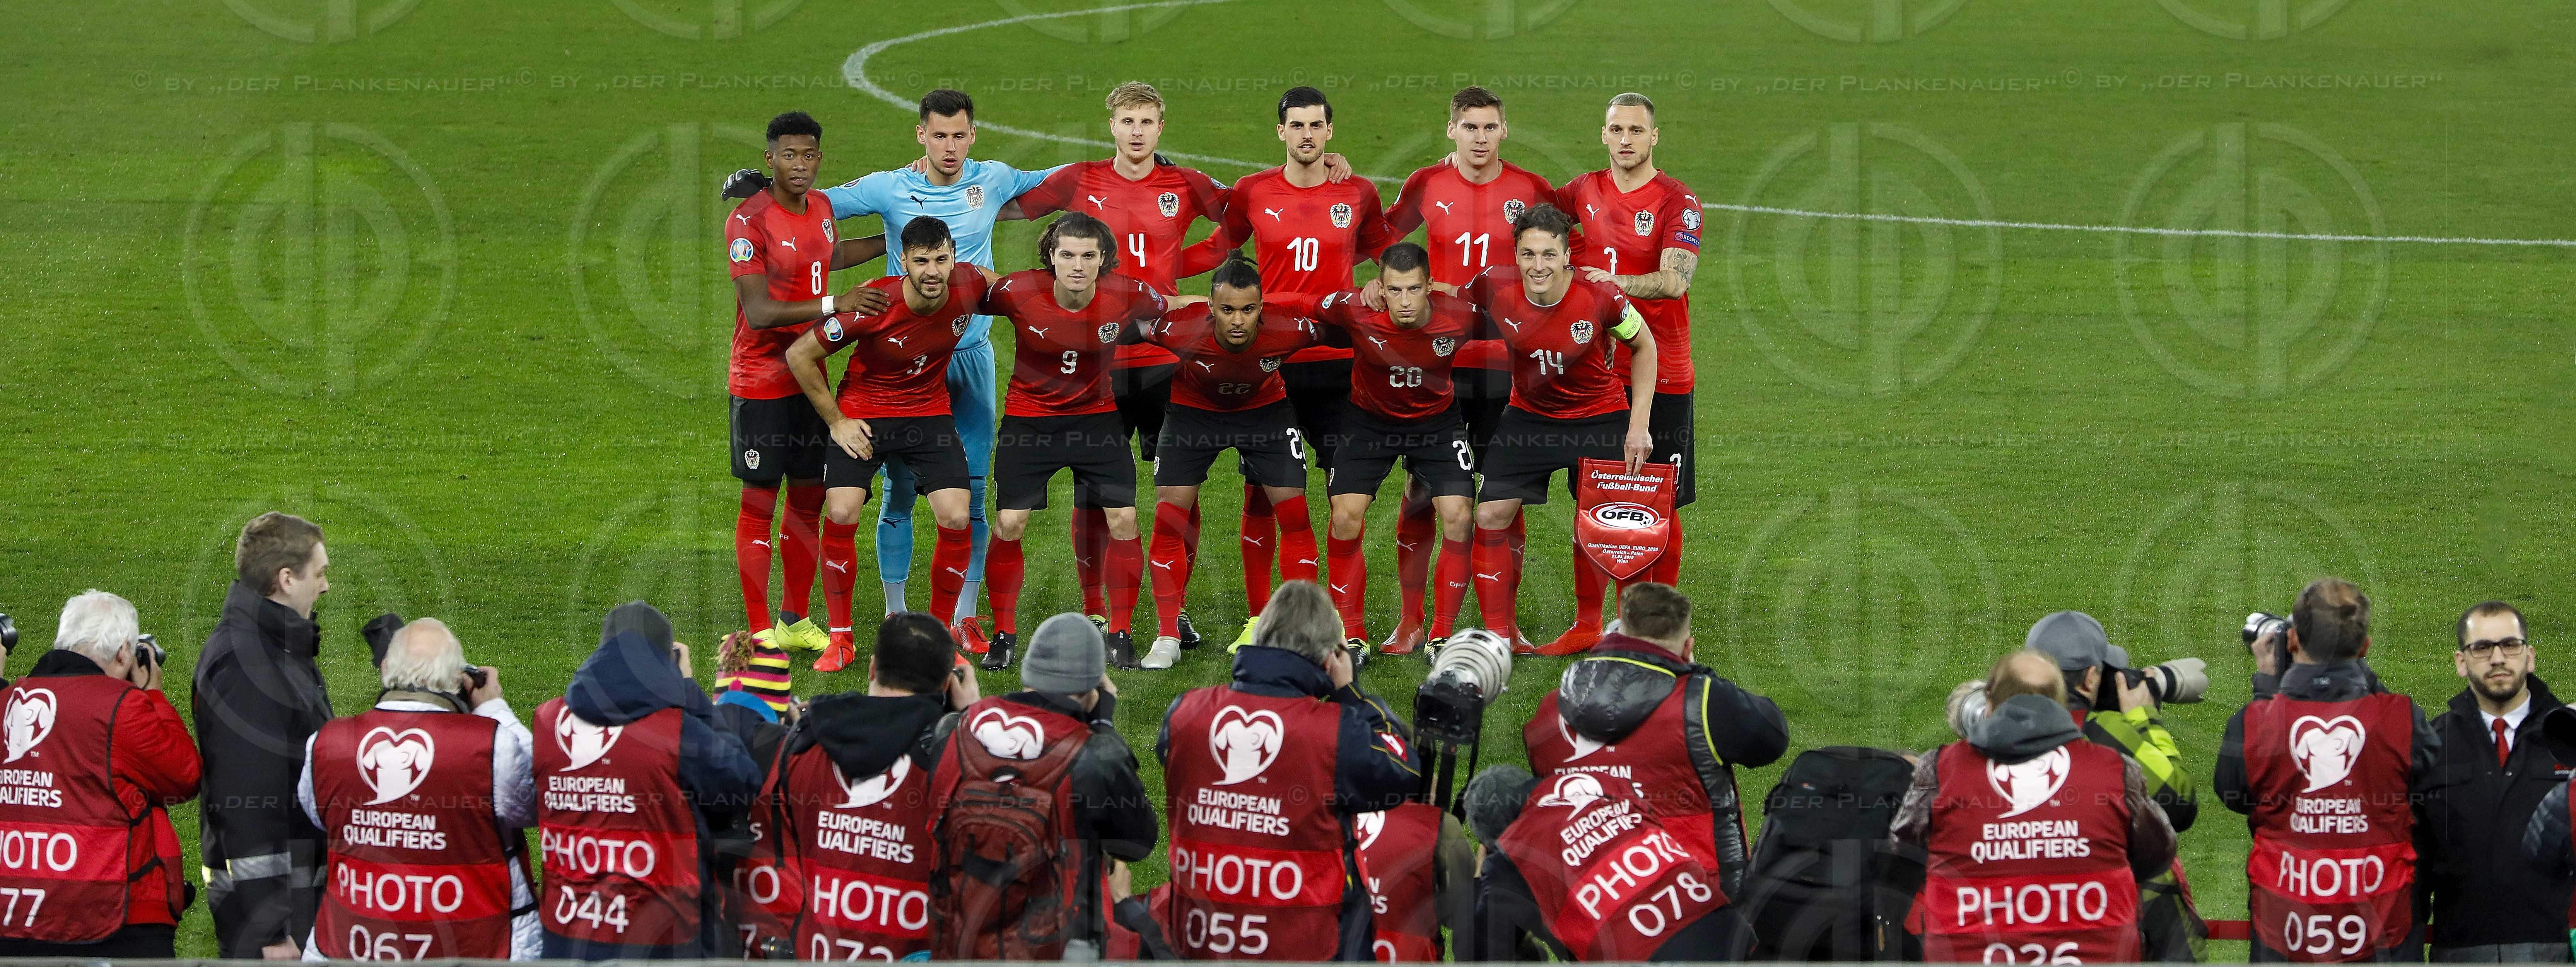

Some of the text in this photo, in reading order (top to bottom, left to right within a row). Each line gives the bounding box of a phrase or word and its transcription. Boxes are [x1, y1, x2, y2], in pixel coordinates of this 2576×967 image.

[1128, 233, 1146, 267] 4
[1287, 237, 1319, 271] 10
[1455, 232, 1490, 267] 11
[811, 261, 822, 295] 8
[907, 355, 928, 375] 3
[1061, 350, 1078, 374] 9
[1390, 365, 1422, 388] 20
[1530, 349, 1563, 375] 14
[1286, 428, 1306, 461] 2
[1452, 440, 1474, 471] 2
[1597, 481, 1657, 493] Fußball-Bund
[0, 769, 53, 788] ROPEAN
[548, 776, 625, 794] EUROPEAN
[0, 787, 62, 808] ALIFIERS
[1197, 787, 1281, 815] EUROPEAN
[351, 808, 436, 831] EUROPEAN
[818, 810, 906, 842] EUROPEAN
[1187, 804, 1290, 837] QUALIFIERS
[1982, 820, 2079, 841] EUROPEAN
[0, 830, 77, 872] OTO
[343, 825, 447, 851] QUALIFIERS
[542, 827, 655, 878] PHOTO
[817, 829, 915, 864] UALIFIERS
[1970, 838, 2091, 864] QUALIFIERS
[337, 863, 463, 913] PHOTO
[1174, 847, 1303, 900] PHOTO
[2277, 851, 2385, 897] PHOTO
[555, 885, 630, 934] 044
[813, 874, 929, 930] HOTO
[1628, 872, 1712, 937] 078
[1957, 880, 2108, 926] PHOTO
[349, 924, 433, 963] 067
[1186, 907, 1269, 955] 055
[2284, 911, 2368, 955] 059
